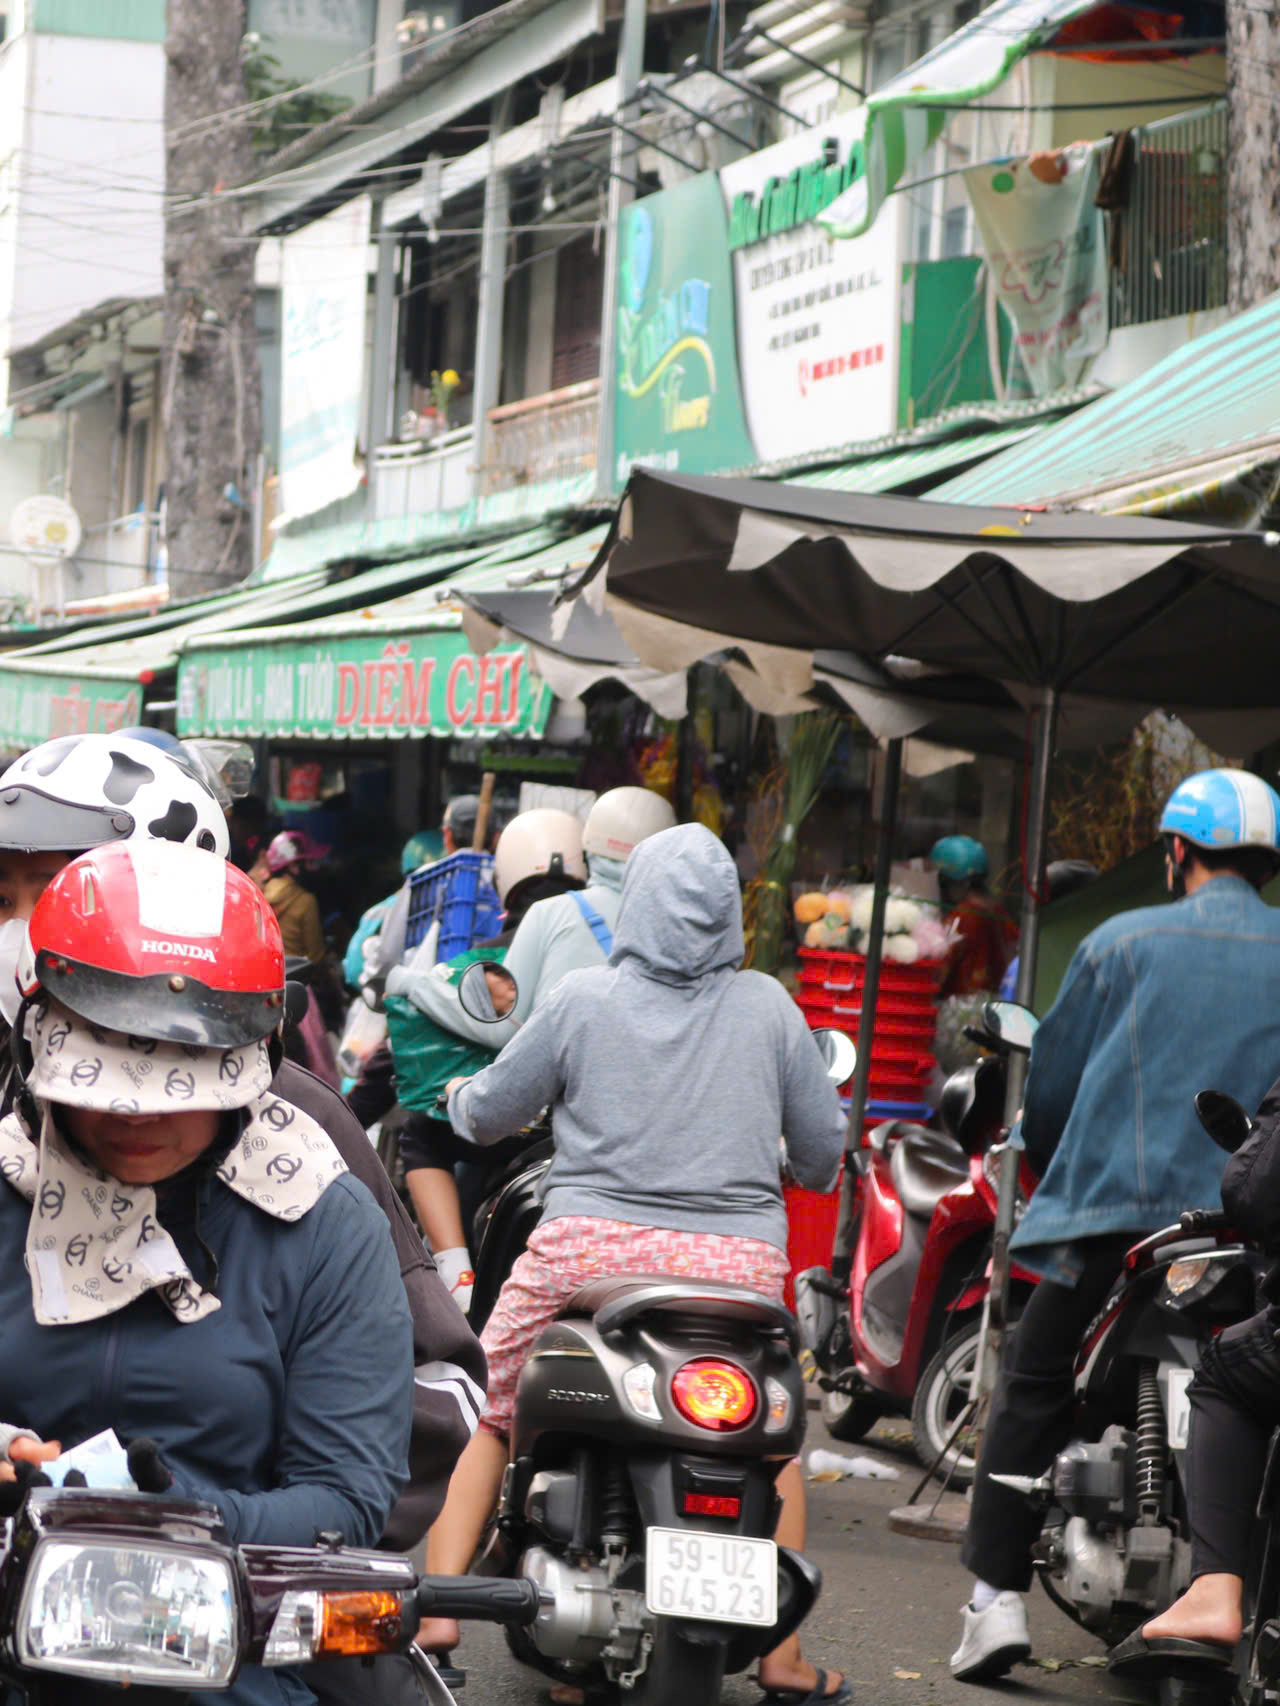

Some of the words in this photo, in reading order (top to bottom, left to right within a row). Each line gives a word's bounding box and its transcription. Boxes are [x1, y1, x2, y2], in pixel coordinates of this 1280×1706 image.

[141, 939, 217, 964] HONDA
[72, 1283, 105, 1302] CHANEL
[667, 1537, 756, 1580] 59-U2
[658, 1575, 766, 1620] 645.23
